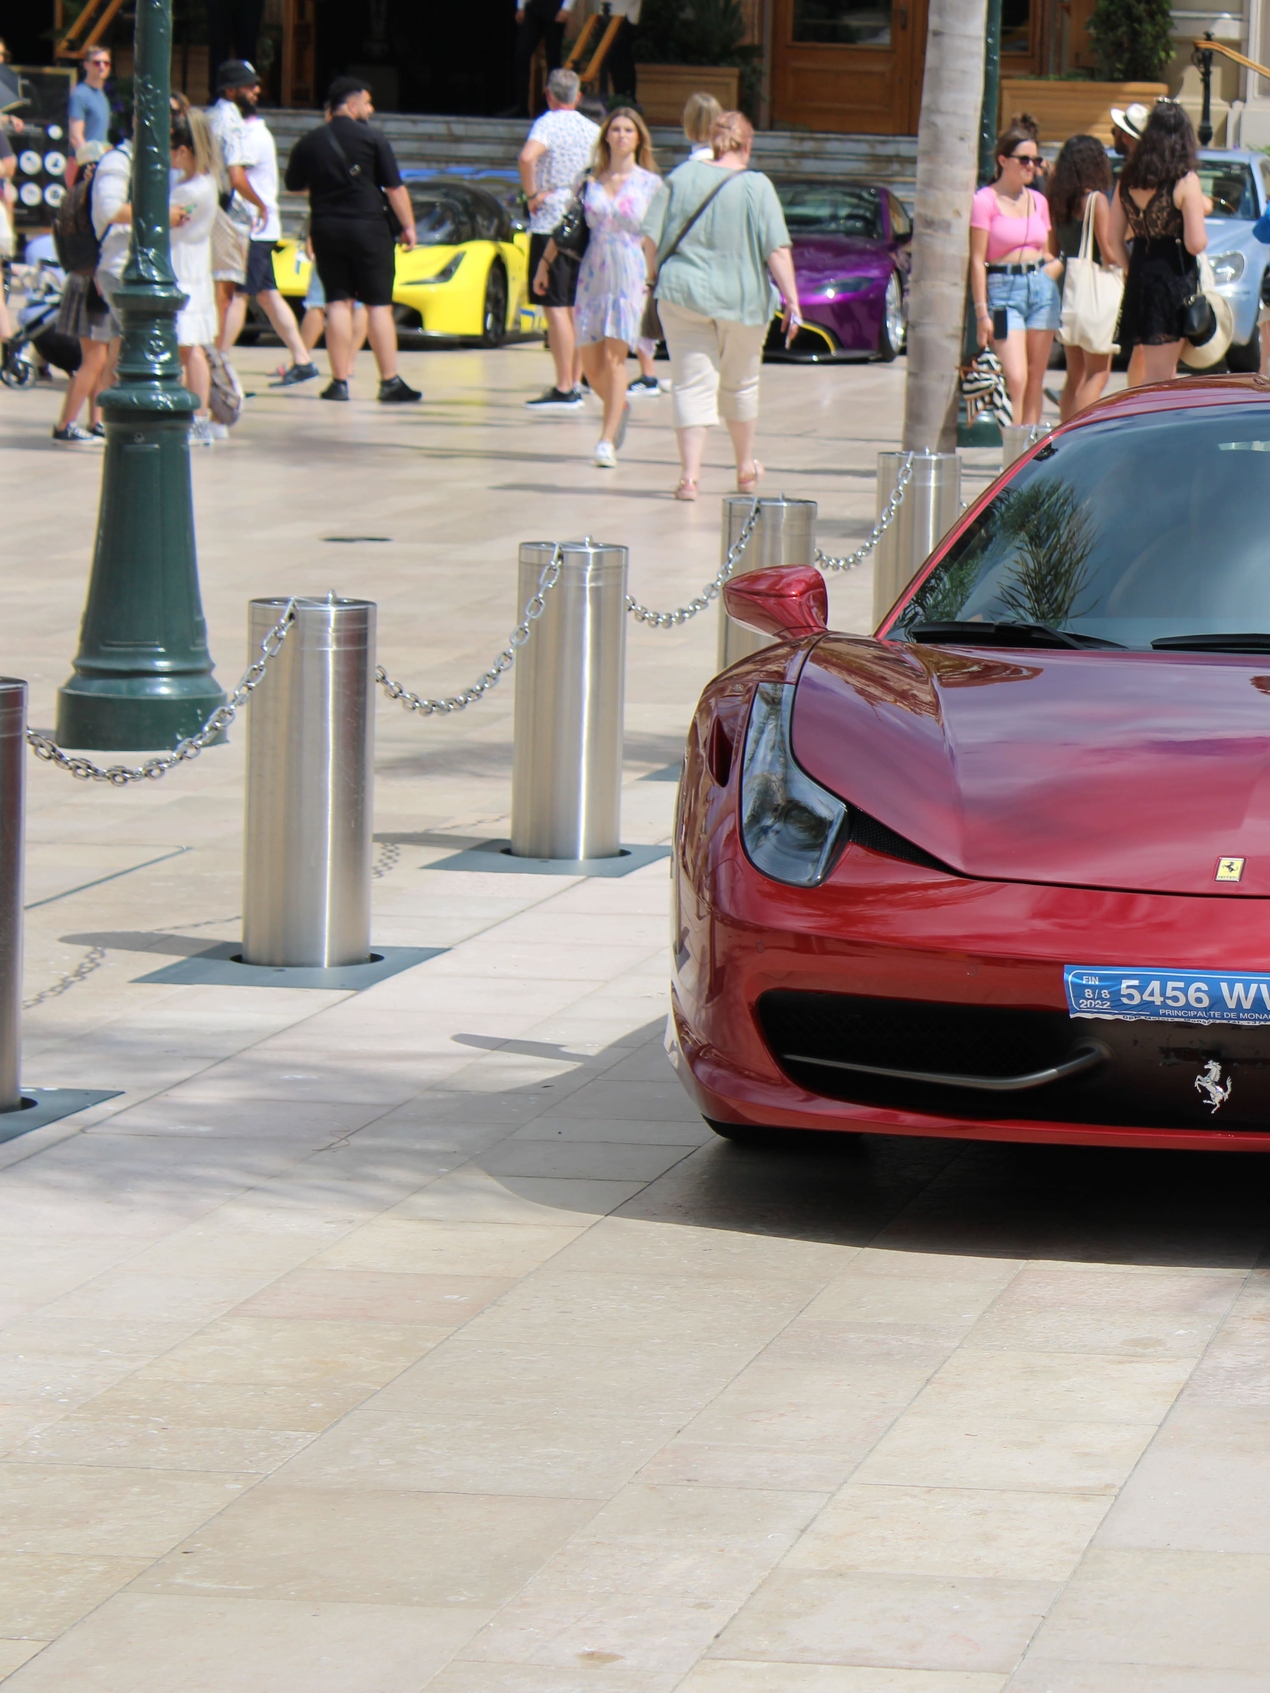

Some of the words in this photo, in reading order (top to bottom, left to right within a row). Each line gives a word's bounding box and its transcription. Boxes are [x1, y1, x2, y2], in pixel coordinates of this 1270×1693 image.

[1082, 975, 1099, 985] FIN
[1084, 988, 1110, 999] 8/8
[1120, 979, 1210, 1008] 5456
[1079, 999, 1111, 1009] 2022
[1223, 1011, 1237, 1019] DE
